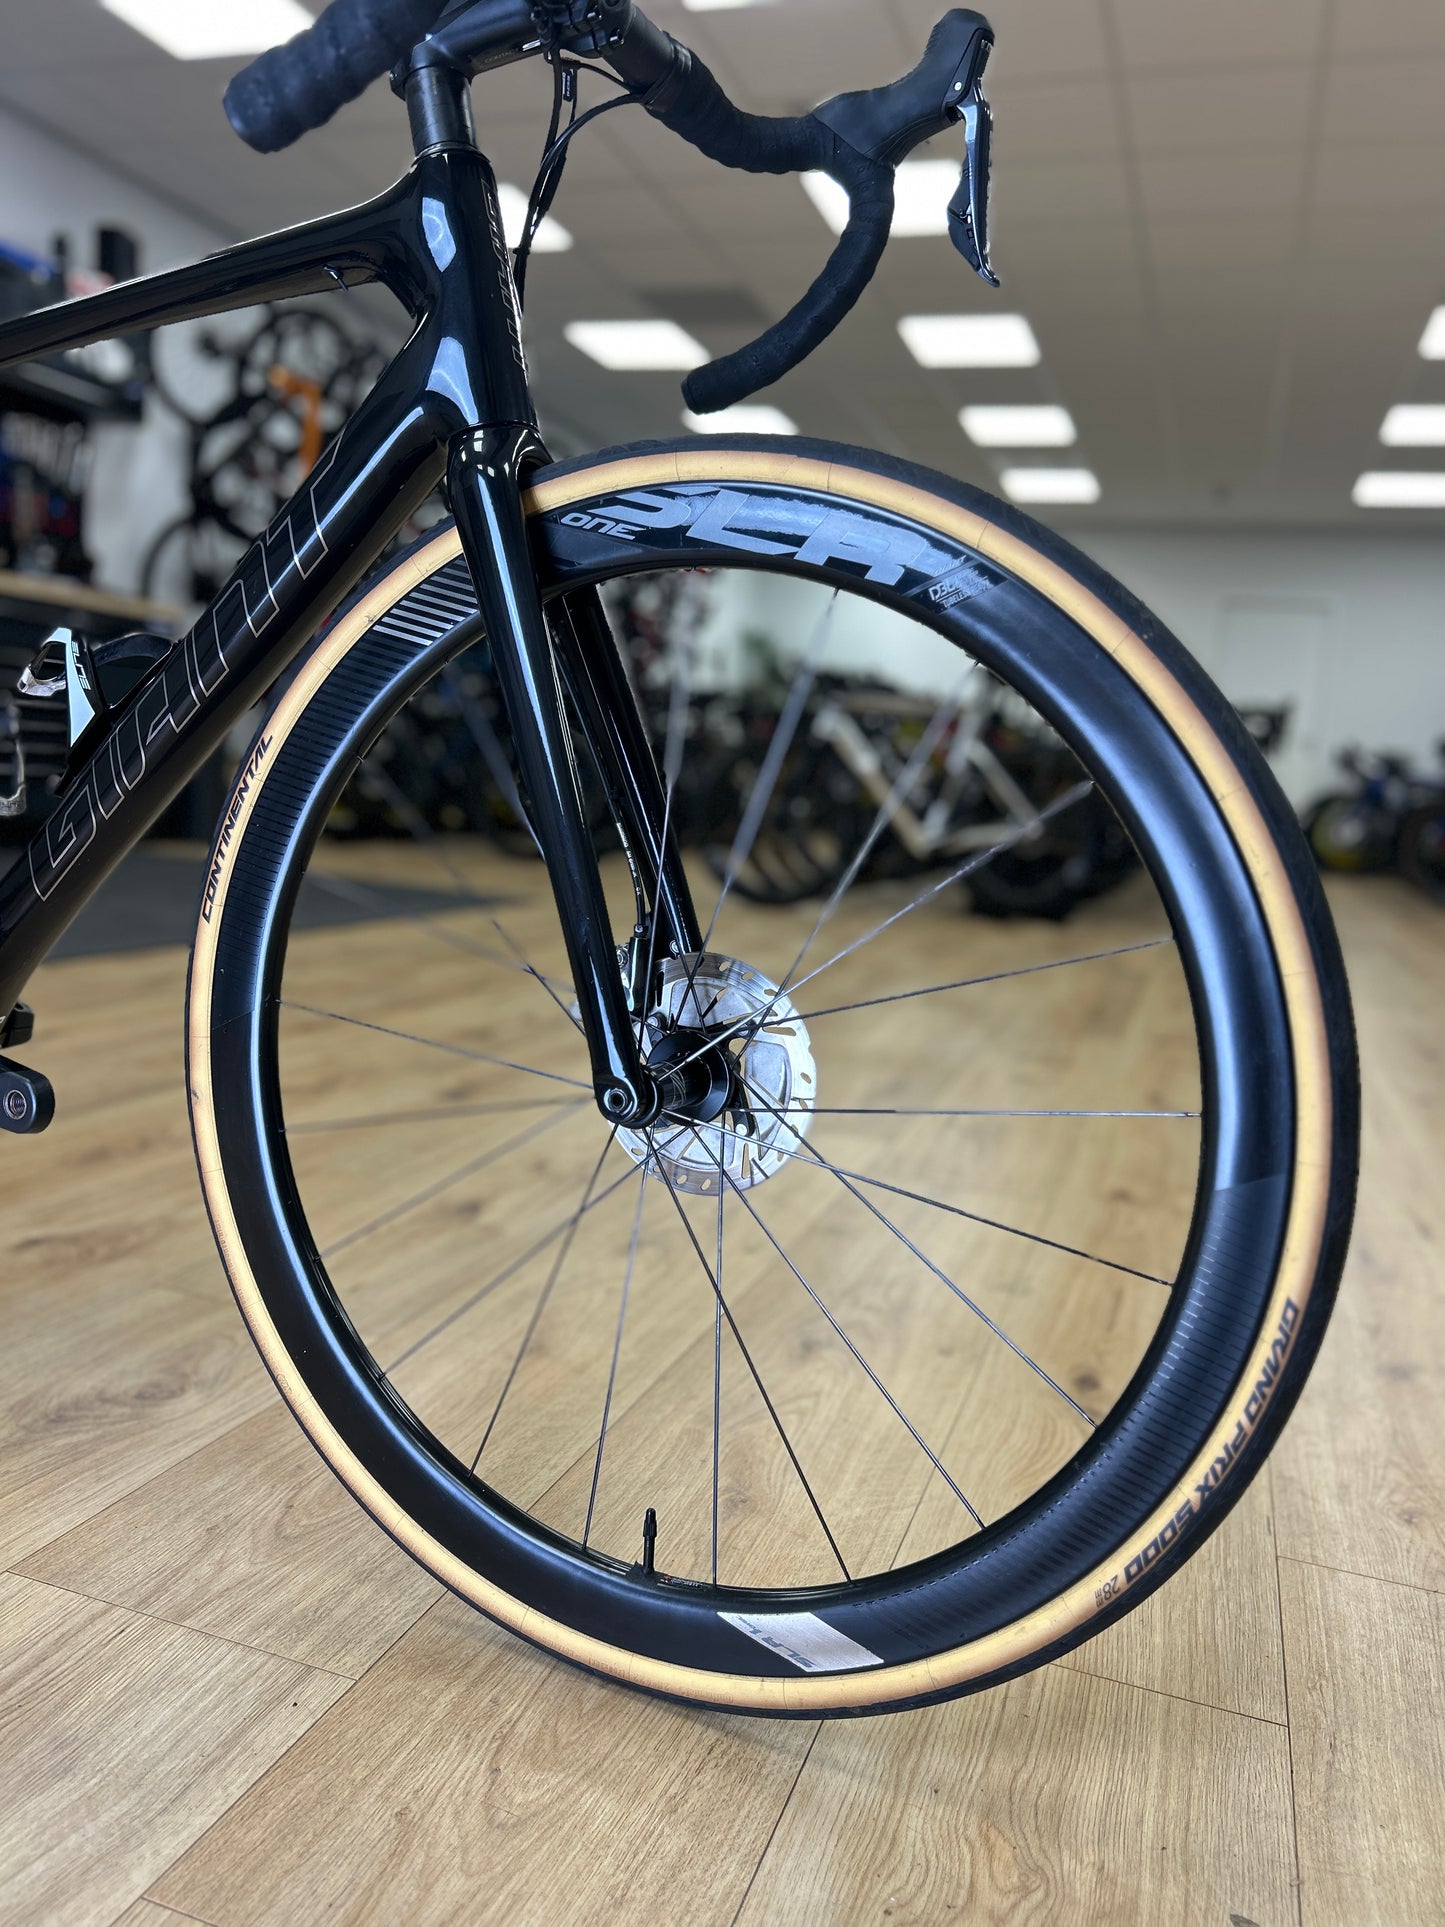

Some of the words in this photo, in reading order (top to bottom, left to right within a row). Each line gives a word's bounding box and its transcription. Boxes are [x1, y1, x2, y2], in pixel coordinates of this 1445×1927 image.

[560, 512, 647, 541] ONE
[587, 485, 927, 586] SLR
[28, 428, 347, 901] GIANT
[201, 734, 273, 924] CONTINENTAL
[1243, 1296, 1299, 1428] GRAND
[1196, 1422, 1250, 1500] PRIX
[1102, 1576, 1121, 1602] 28
[1123, 1497, 1195, 1586] 5000
